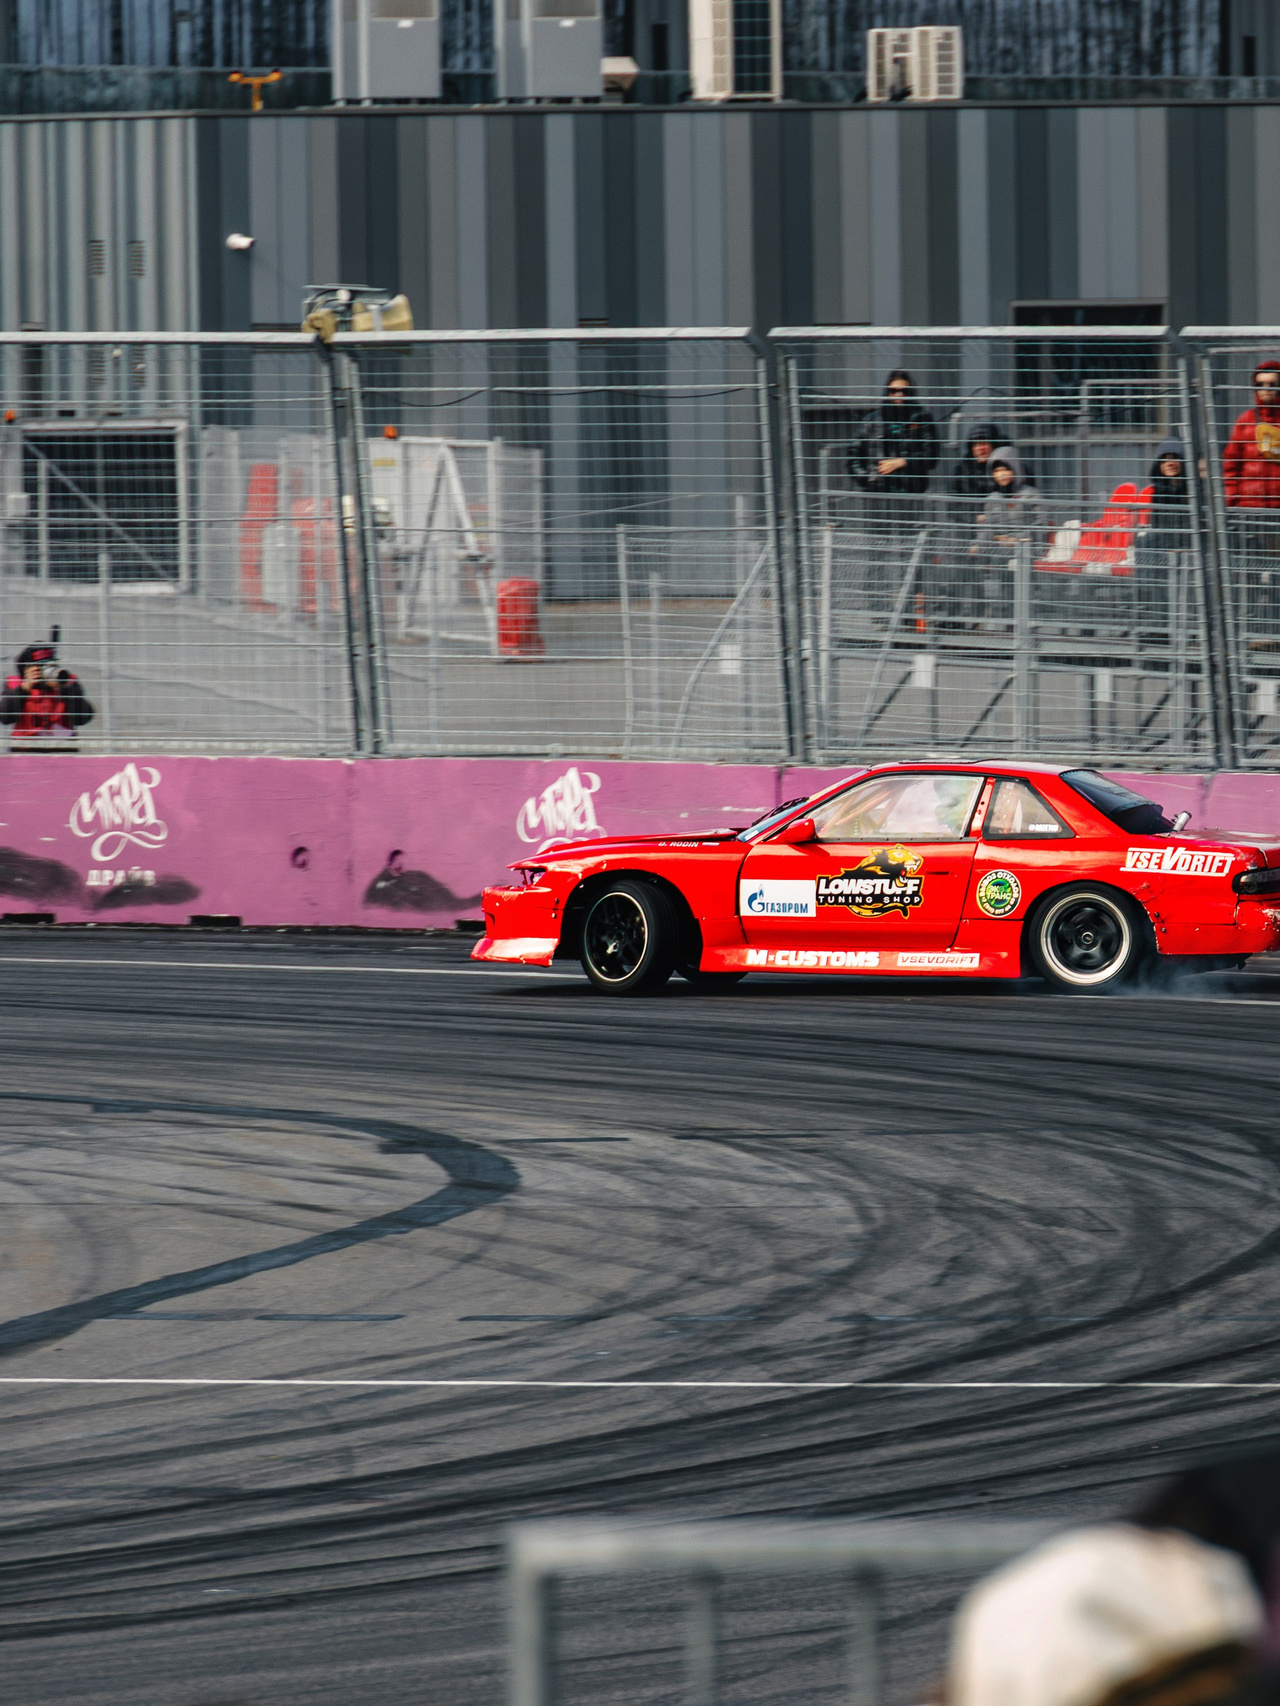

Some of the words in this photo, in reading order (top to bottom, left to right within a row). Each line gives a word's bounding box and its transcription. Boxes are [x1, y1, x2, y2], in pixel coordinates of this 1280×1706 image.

[818, 895, 873, 904] TUNING
[883, 896, 920, 904] SHOP
[766, 902, 808, 913] ГАЗПРОМ
